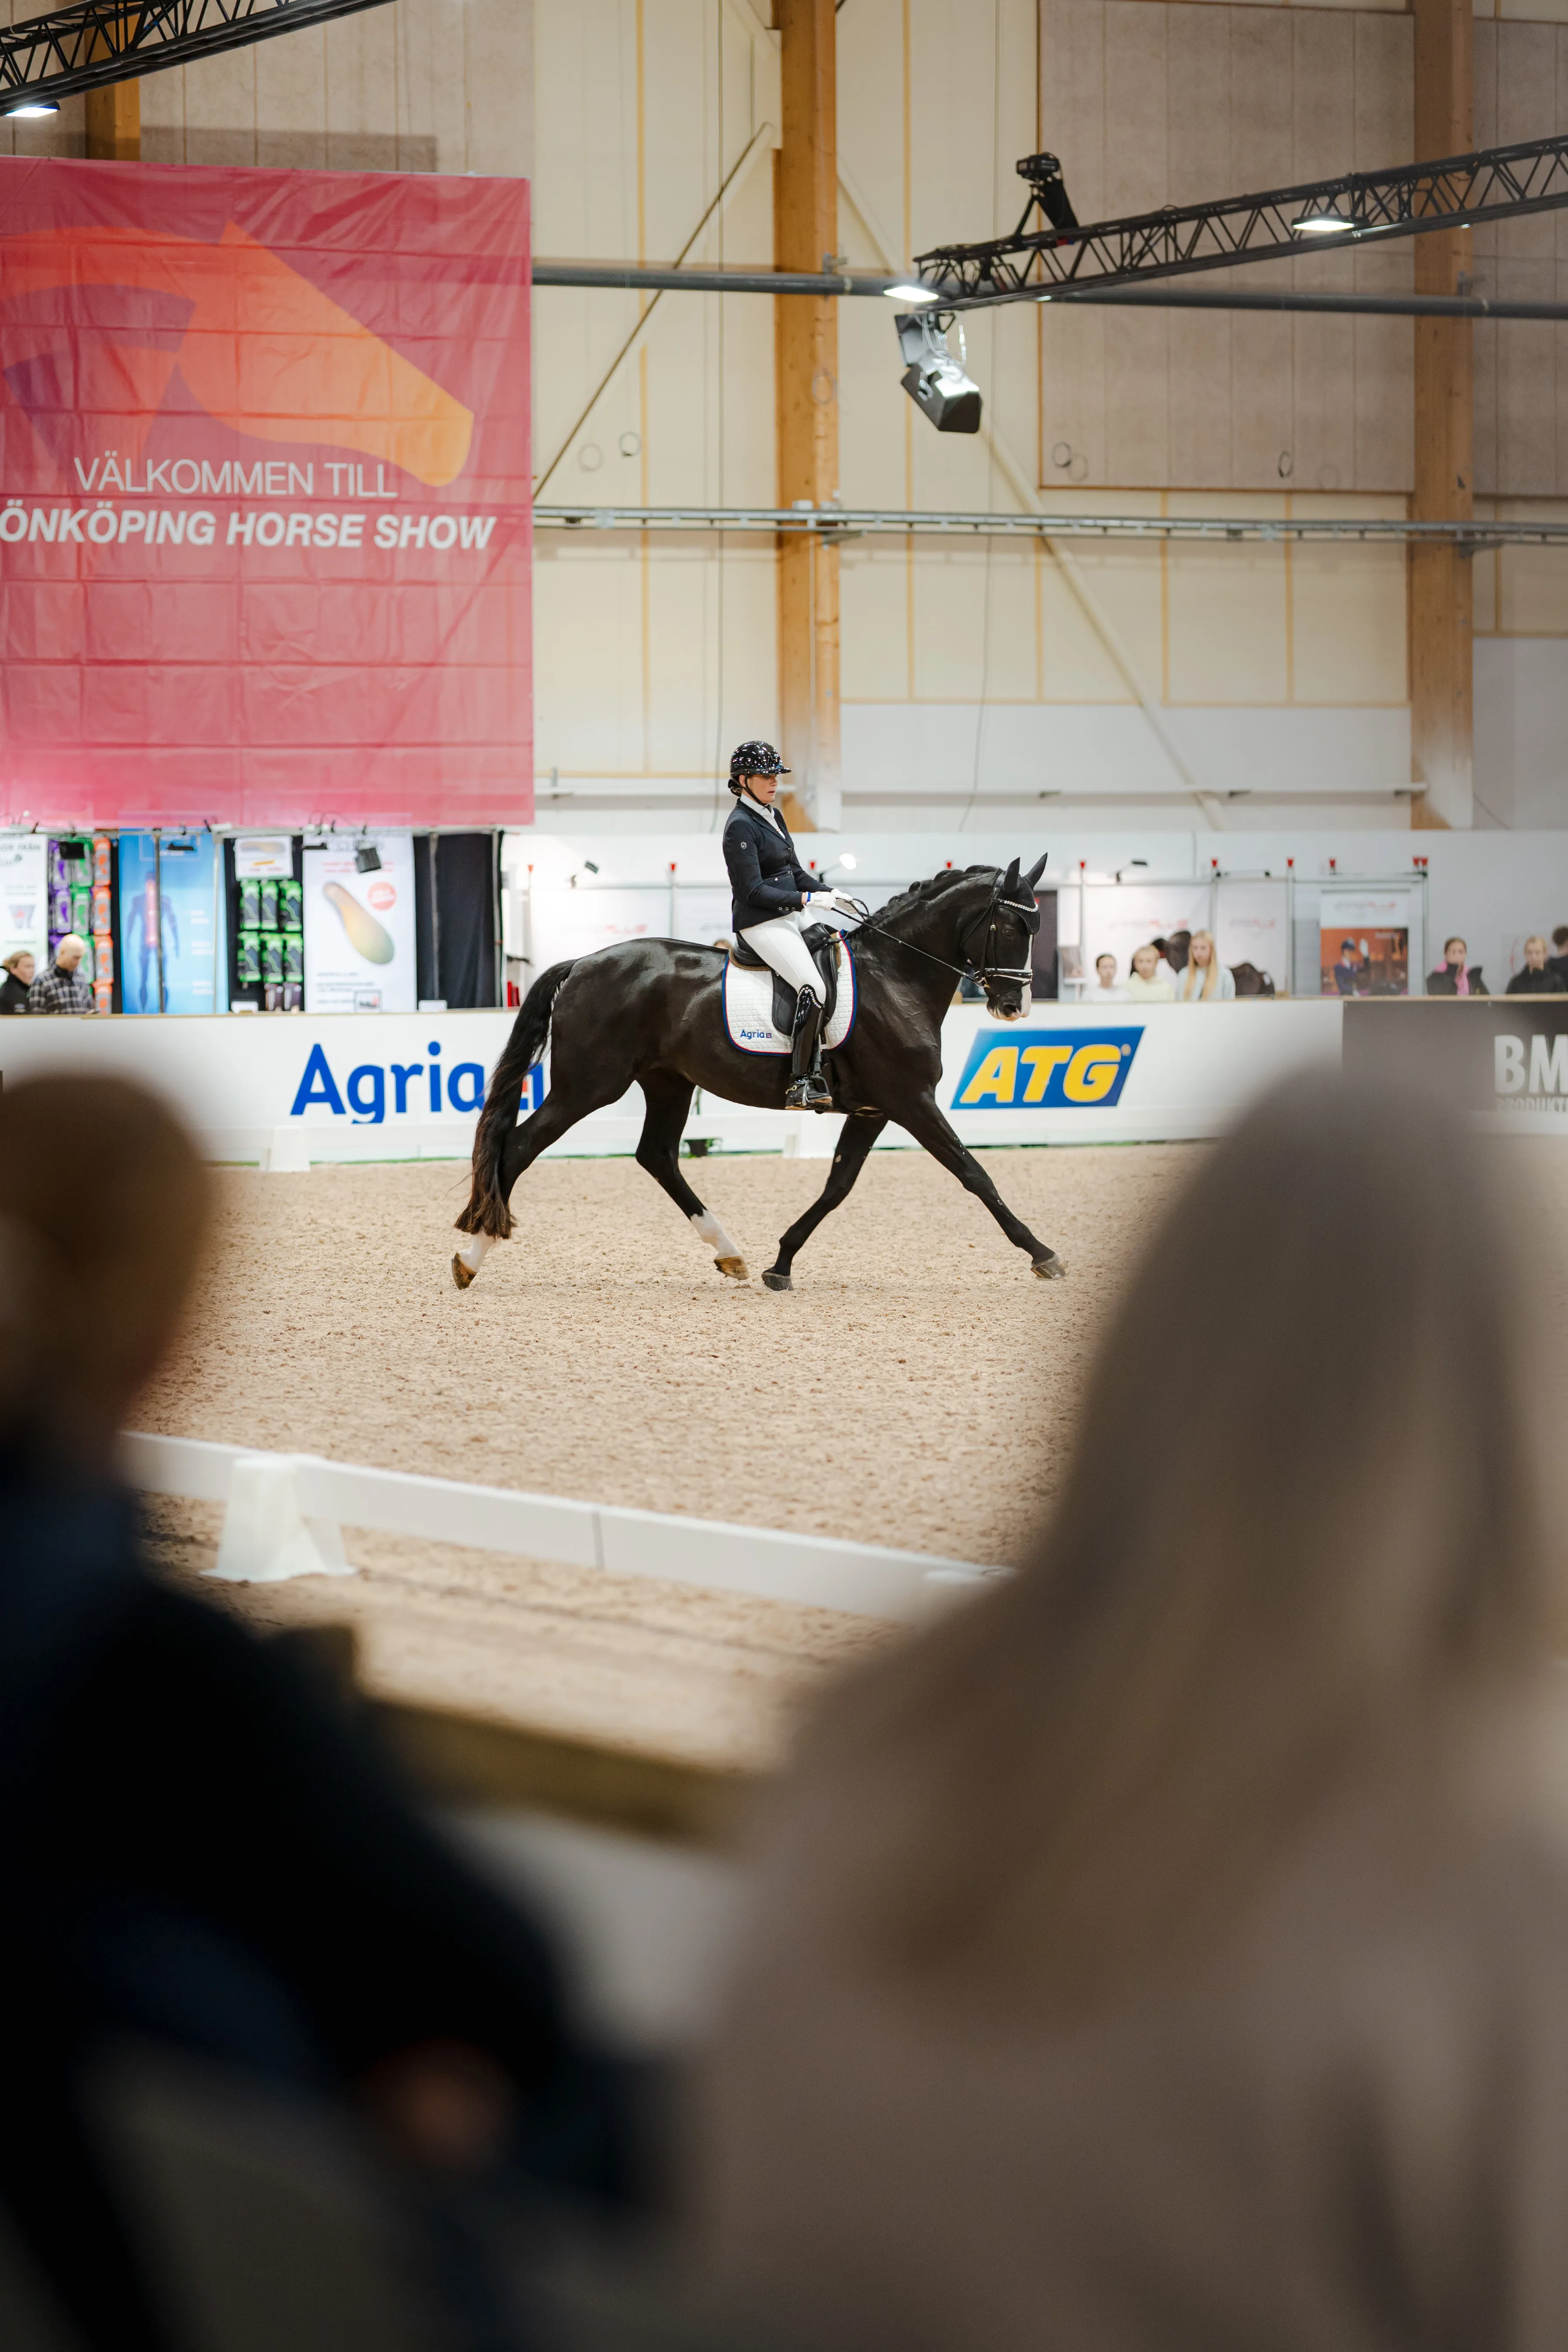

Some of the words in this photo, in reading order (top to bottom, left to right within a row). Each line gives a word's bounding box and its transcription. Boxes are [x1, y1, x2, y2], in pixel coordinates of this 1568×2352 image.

[74, 450, 313, 495] VÄLKOMMEN
[324, 462, 398, 497] TILL
[0, 499, 216, 544] ÖNKÖPING
[226, 512, 366, 548] HORSE
[373, 514, 497, 549] SHOW
[740, 1029, 765, 1039] Agria
[290, 1040, 485, 1124] Agria
[959, 1044, 1121, 1103] ATG
[1495, 1097, 1568, 1112] PRODUKT
